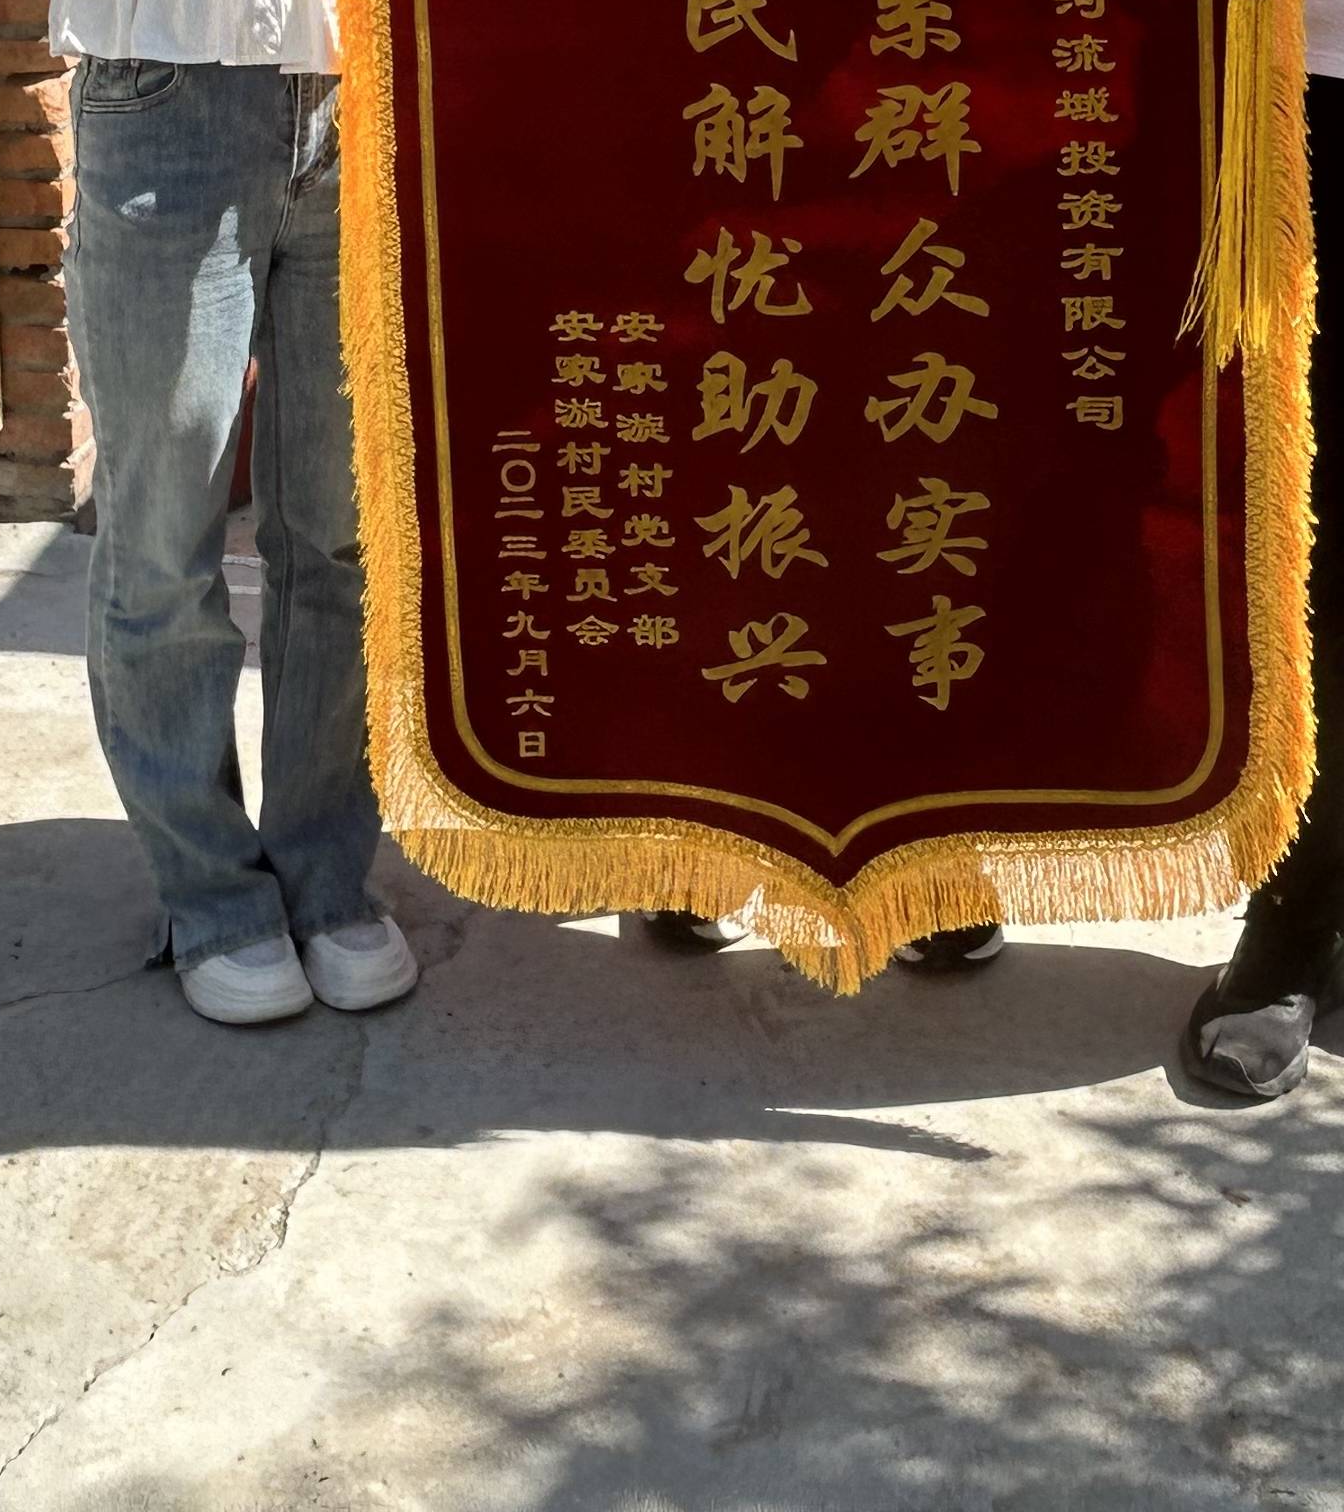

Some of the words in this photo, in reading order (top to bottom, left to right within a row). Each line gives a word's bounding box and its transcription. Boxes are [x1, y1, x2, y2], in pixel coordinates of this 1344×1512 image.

[548, 310, 620, 646] 安家漩村民委员会
[609, 311, 680, 650] 安家漩村党支部
